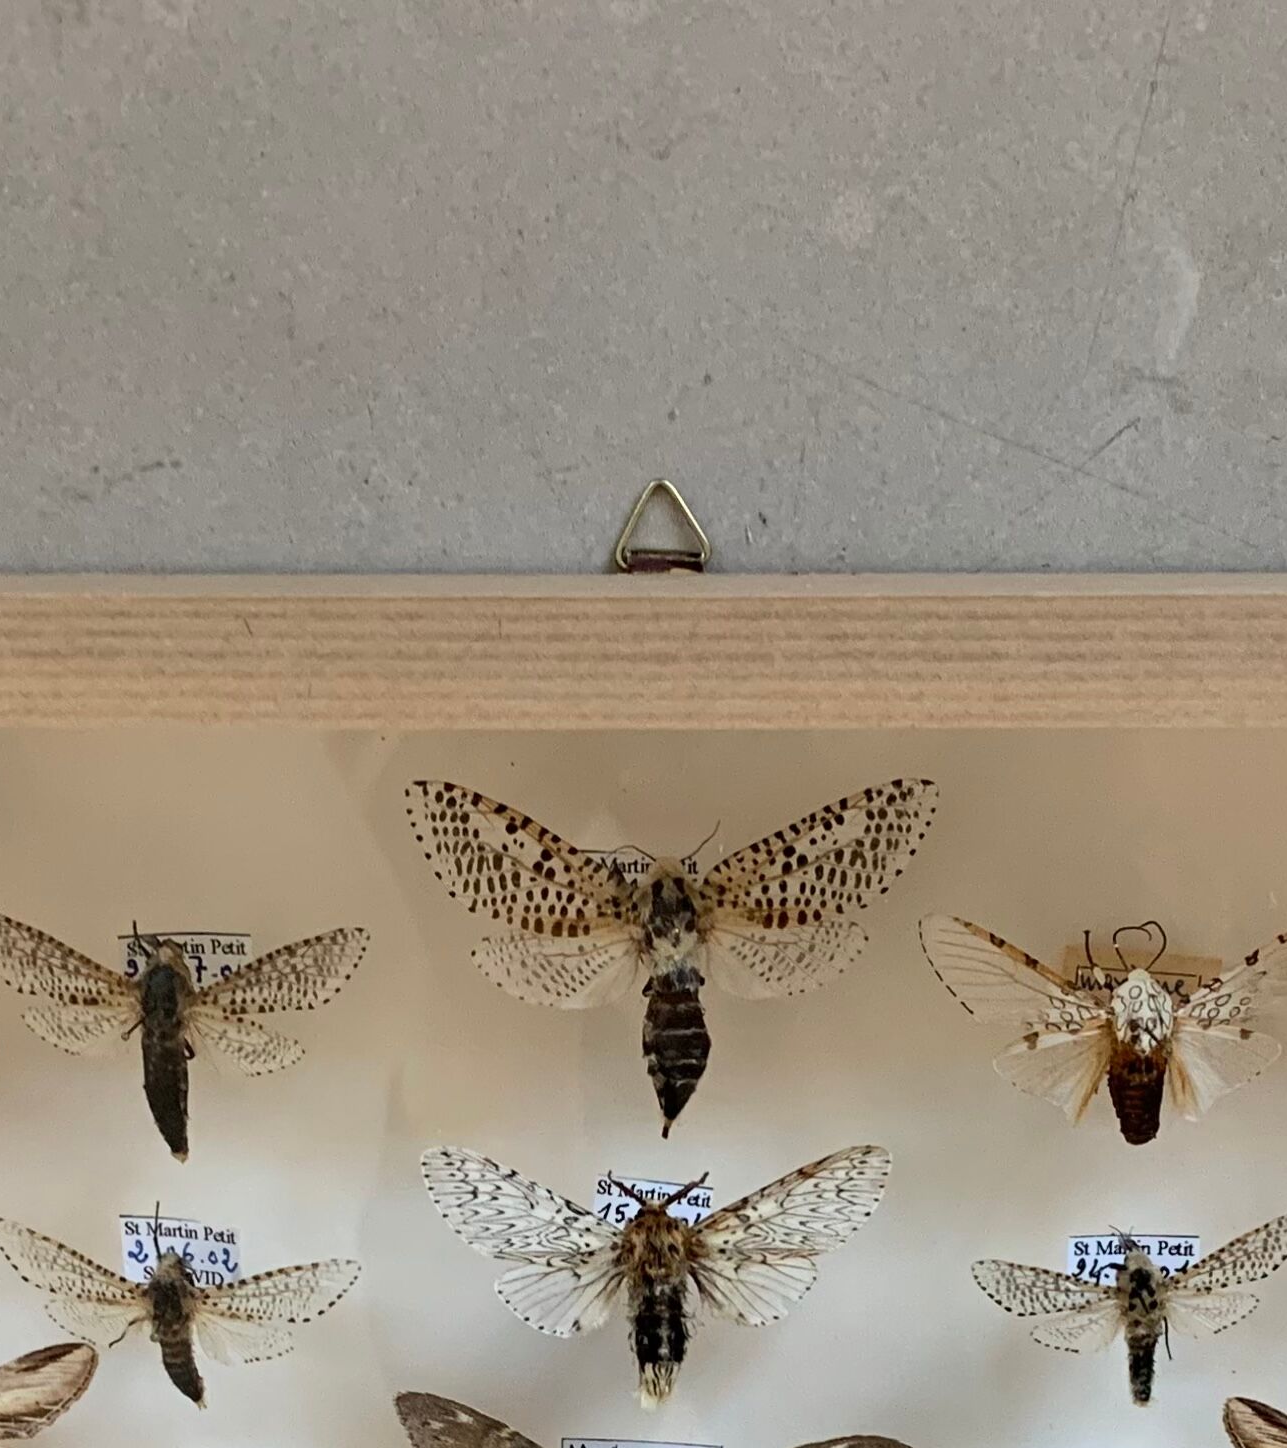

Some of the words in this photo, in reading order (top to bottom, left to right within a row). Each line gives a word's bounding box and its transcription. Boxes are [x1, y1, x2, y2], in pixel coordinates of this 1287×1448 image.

[210, 939, 247, 955] Petit
[597, 1180, 612, 1195] St
[124, 1221, 141, 1237] St
[146, 1221, 198, 1240] Martin
[203, 1226, 236, 1245] Petit
[1074, 1241, 1090, 1256] St
[1096, 1240, 1151, 1256] Main
[1157, 1240, 1195, 1257] Petit
